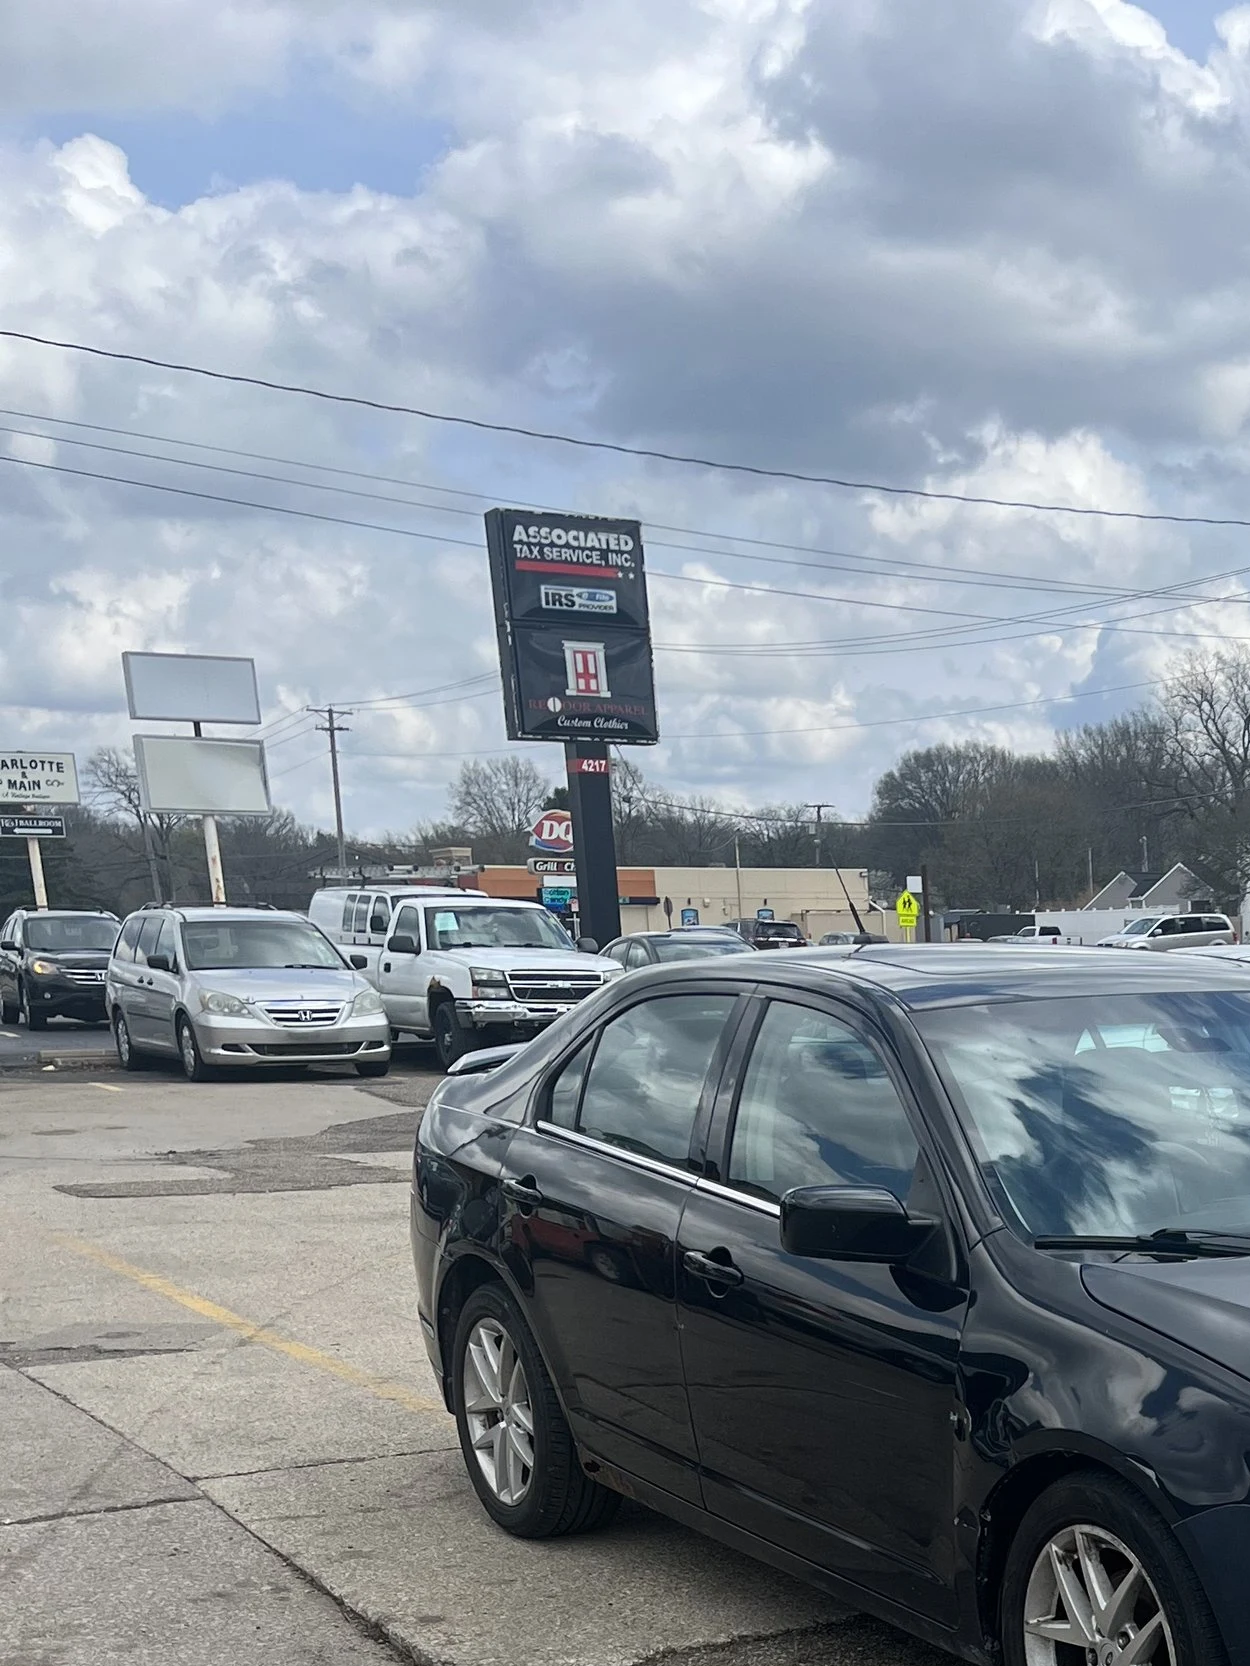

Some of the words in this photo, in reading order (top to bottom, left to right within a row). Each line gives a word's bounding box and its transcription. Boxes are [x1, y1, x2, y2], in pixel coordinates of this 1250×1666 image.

[513, 525, 634, 551] ASSOCIATED
[514, 544, 541, 559] TAX
[543, 546, 605, 566] SERVICE,
[608, 552, 635, 567] INC.
[544, 592, 576, 608] IRS
[578, 603, 614, 611] PROVIDER
[595, 703, 646, 716] APPAREL
[557, 715, 591, 728] Custom
[593, 716, 629, 729] Clothier
[0, 758, 65, 773] ARLOTTE
[581, 760, 606, 772] 4217
[7, 779, 41, 791] MAIN
[541, 820, 573, 844] DQ
[535, 862, 557, 872] Grill
